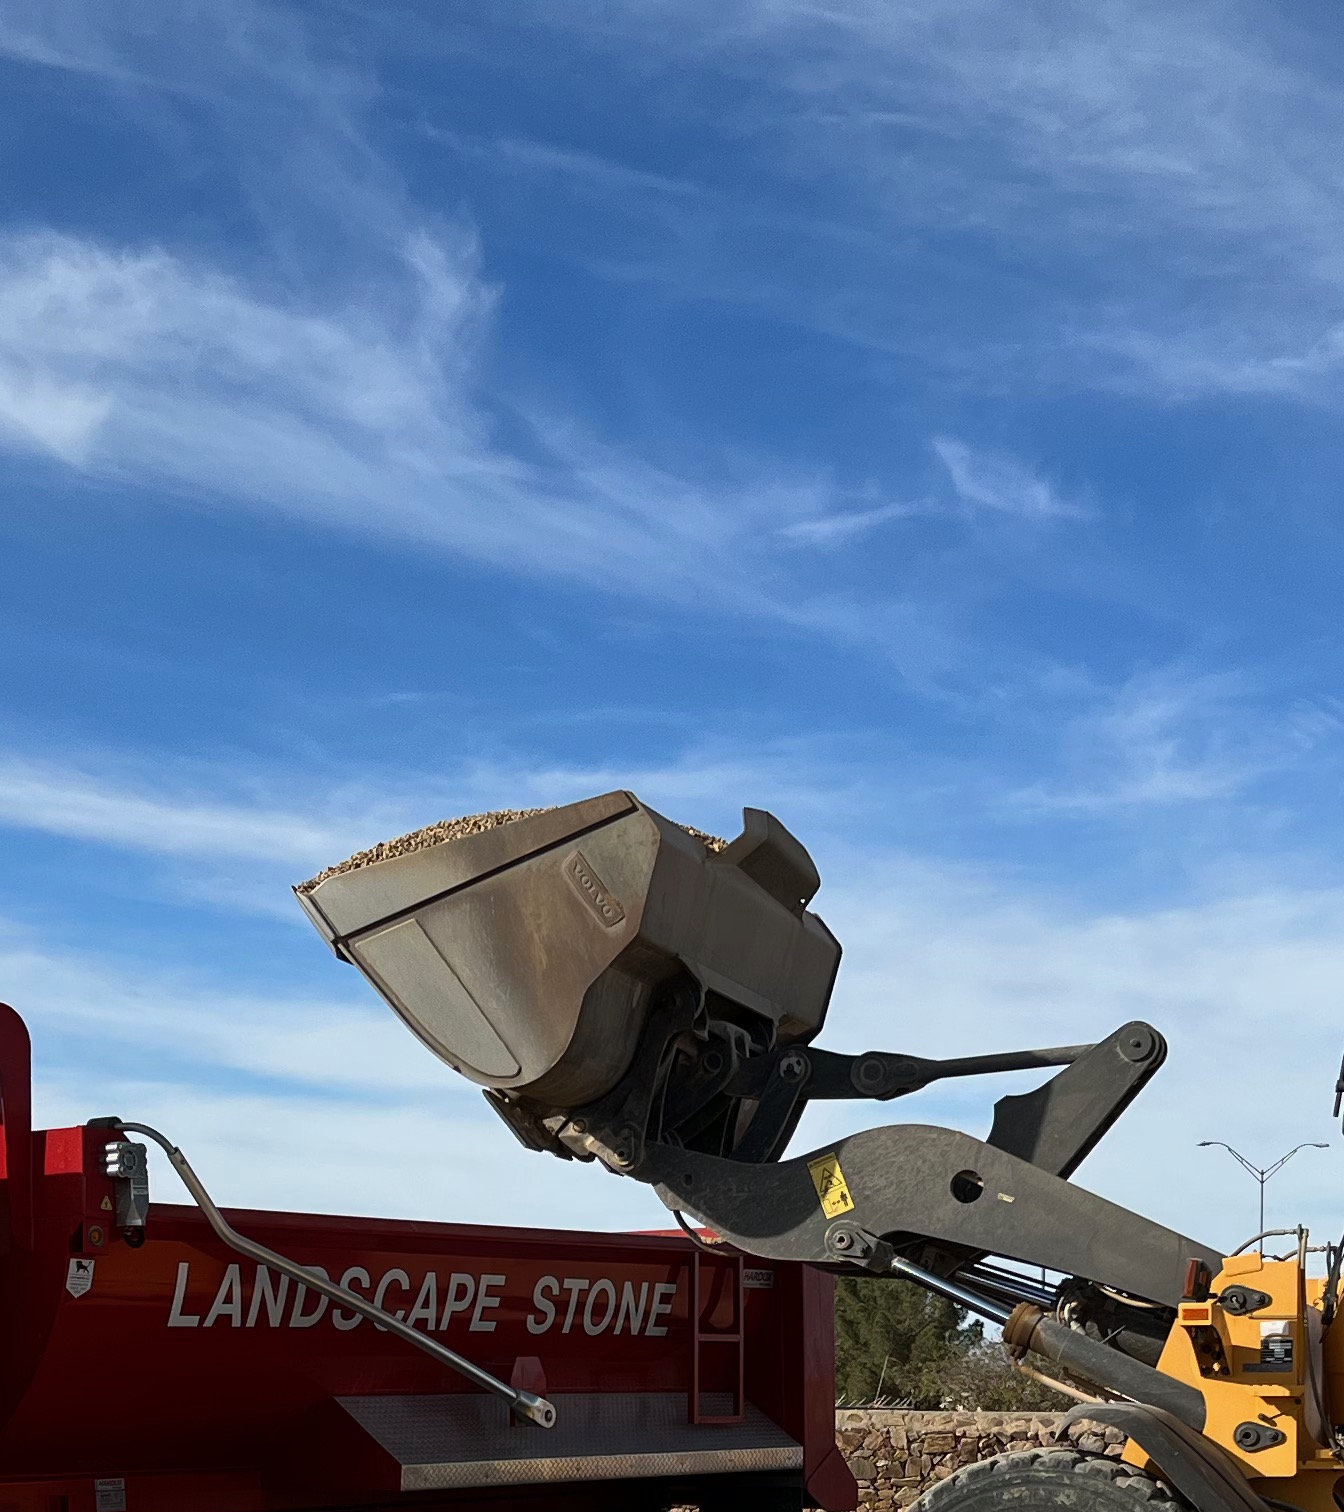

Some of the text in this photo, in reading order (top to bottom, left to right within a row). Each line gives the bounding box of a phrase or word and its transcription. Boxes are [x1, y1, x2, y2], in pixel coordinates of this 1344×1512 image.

[573, 860, 613, 917] VOLVO
[167, 1262, 676, 1337] LANDSCAPE STONE
